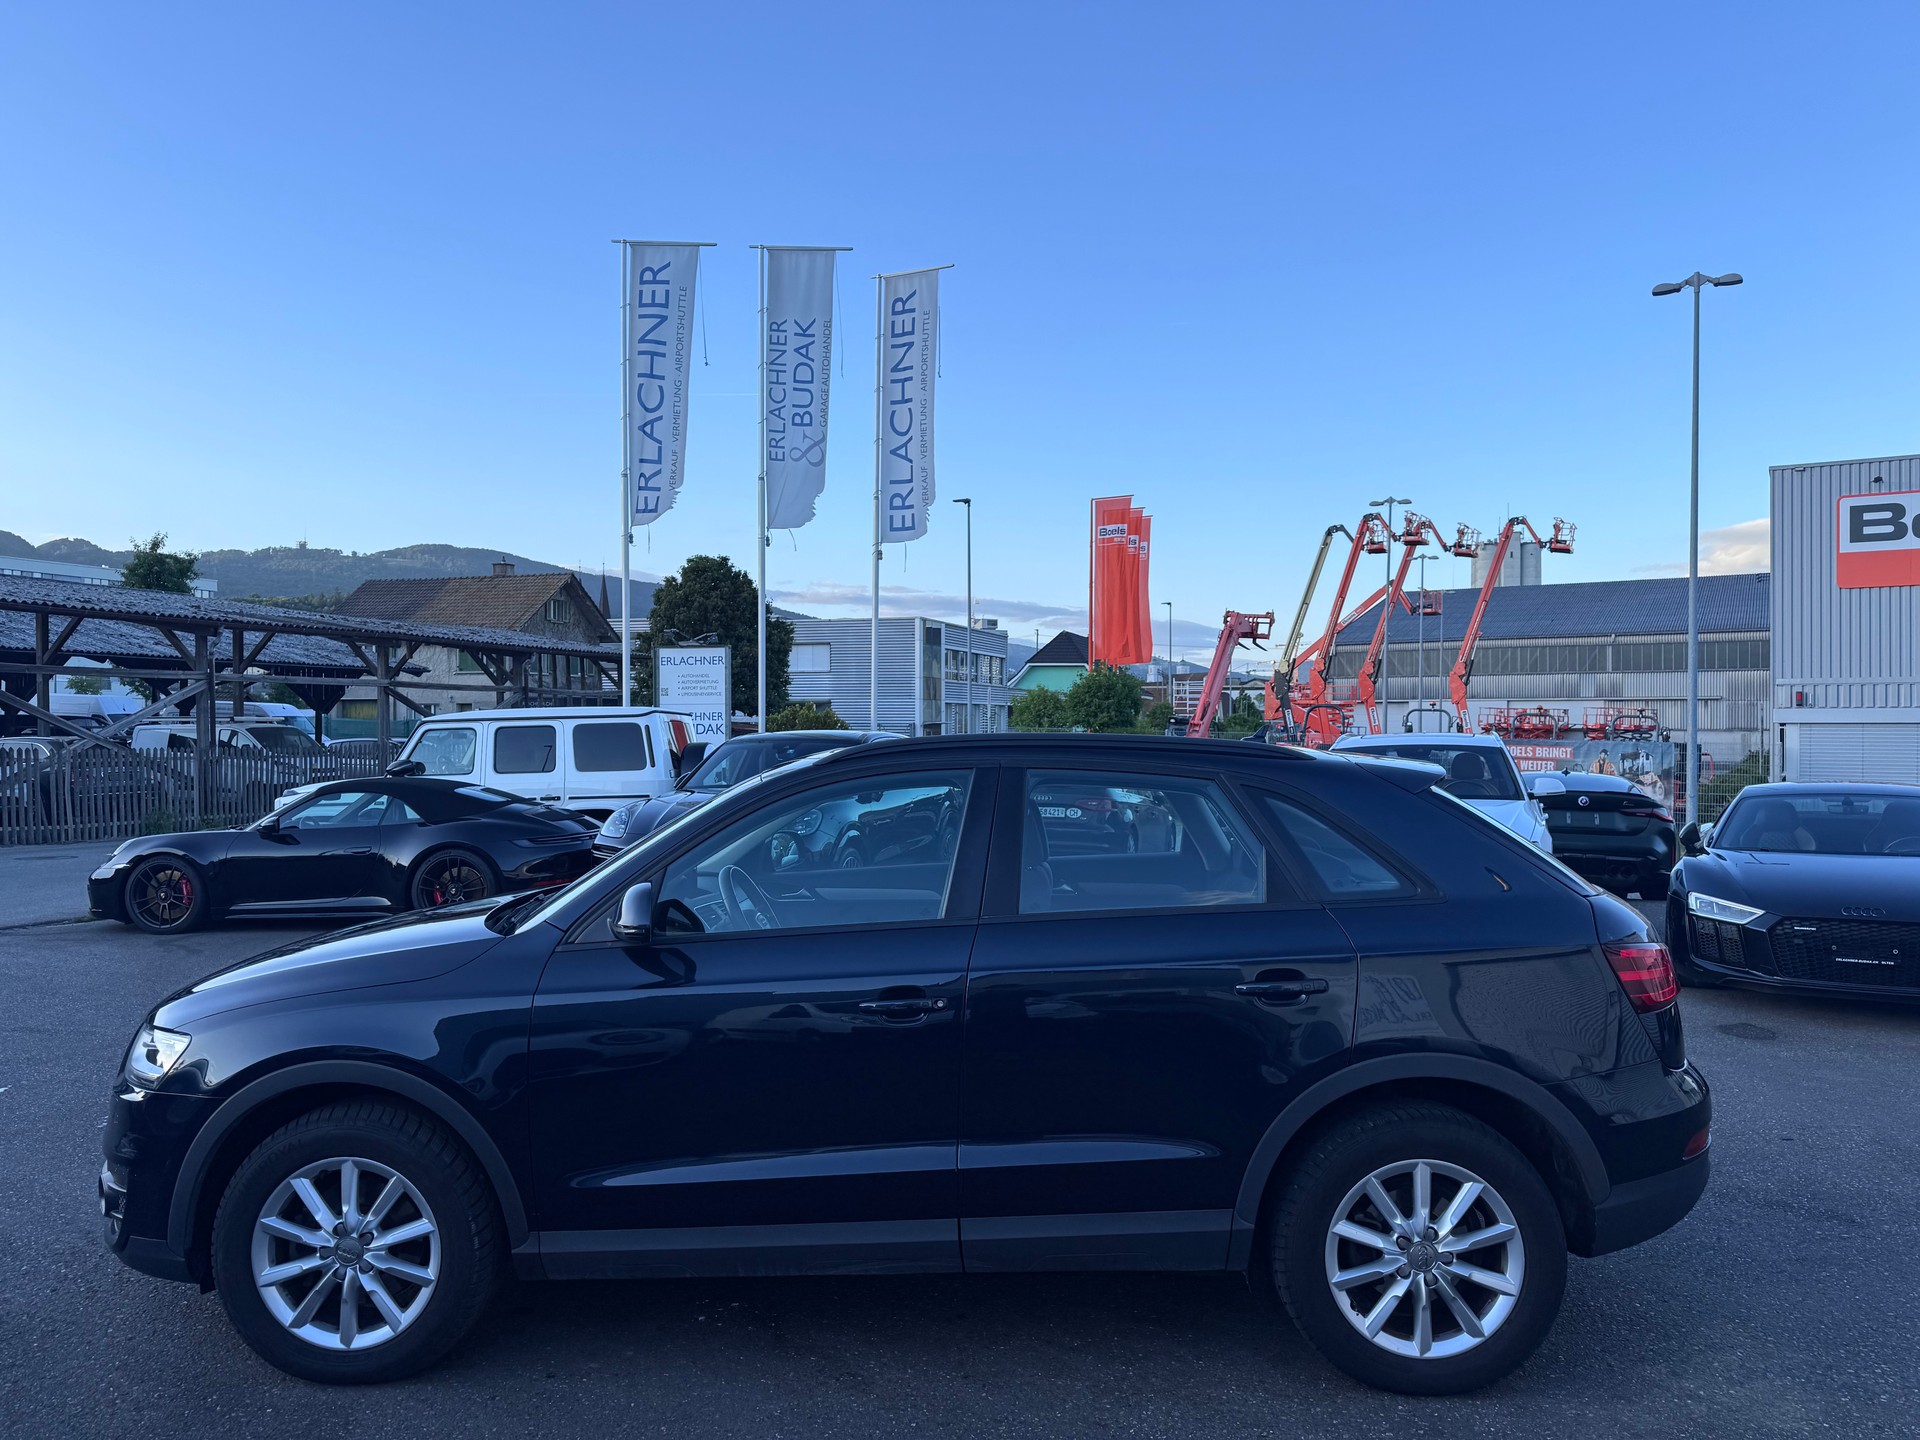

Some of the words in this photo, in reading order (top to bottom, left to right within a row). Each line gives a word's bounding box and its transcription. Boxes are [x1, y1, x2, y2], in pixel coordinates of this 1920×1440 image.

[674, 285, 687, 373] AIRPORTSHUTTLE
[821, 318, 832, 388] AUTOHANDEL
[920, 310, 930, 392] AIRPORTSHUTTLE
[636, 261, 671, 514] ERLACHNER
[769, 318, 788, 462] ERLACHNER
[791, 317, 816, 427] BUDAK
[672, 379, 682, 443] VERMIETUNG
[820, 388, 829, 428] GARAGE
[889, 289, 917, 532] ERLACHNER
[920, 398, 928, 460] VERMIETUNG
[668, 449, 679, 491] VERKAUF
[789, 429, 826, 468] &
[921, 467, 930, 508] VERKAUF
[1099, 526, 1126, 536] Boels
[1850, 502, 1920, 543] B
[660, 656, 724, 666] ERLACHNER
[1506, 746, 1533, 757] OELS
[1536, 746, 1572, 758] BRINGT
[1520, 760, 1554, 770] WEITER
